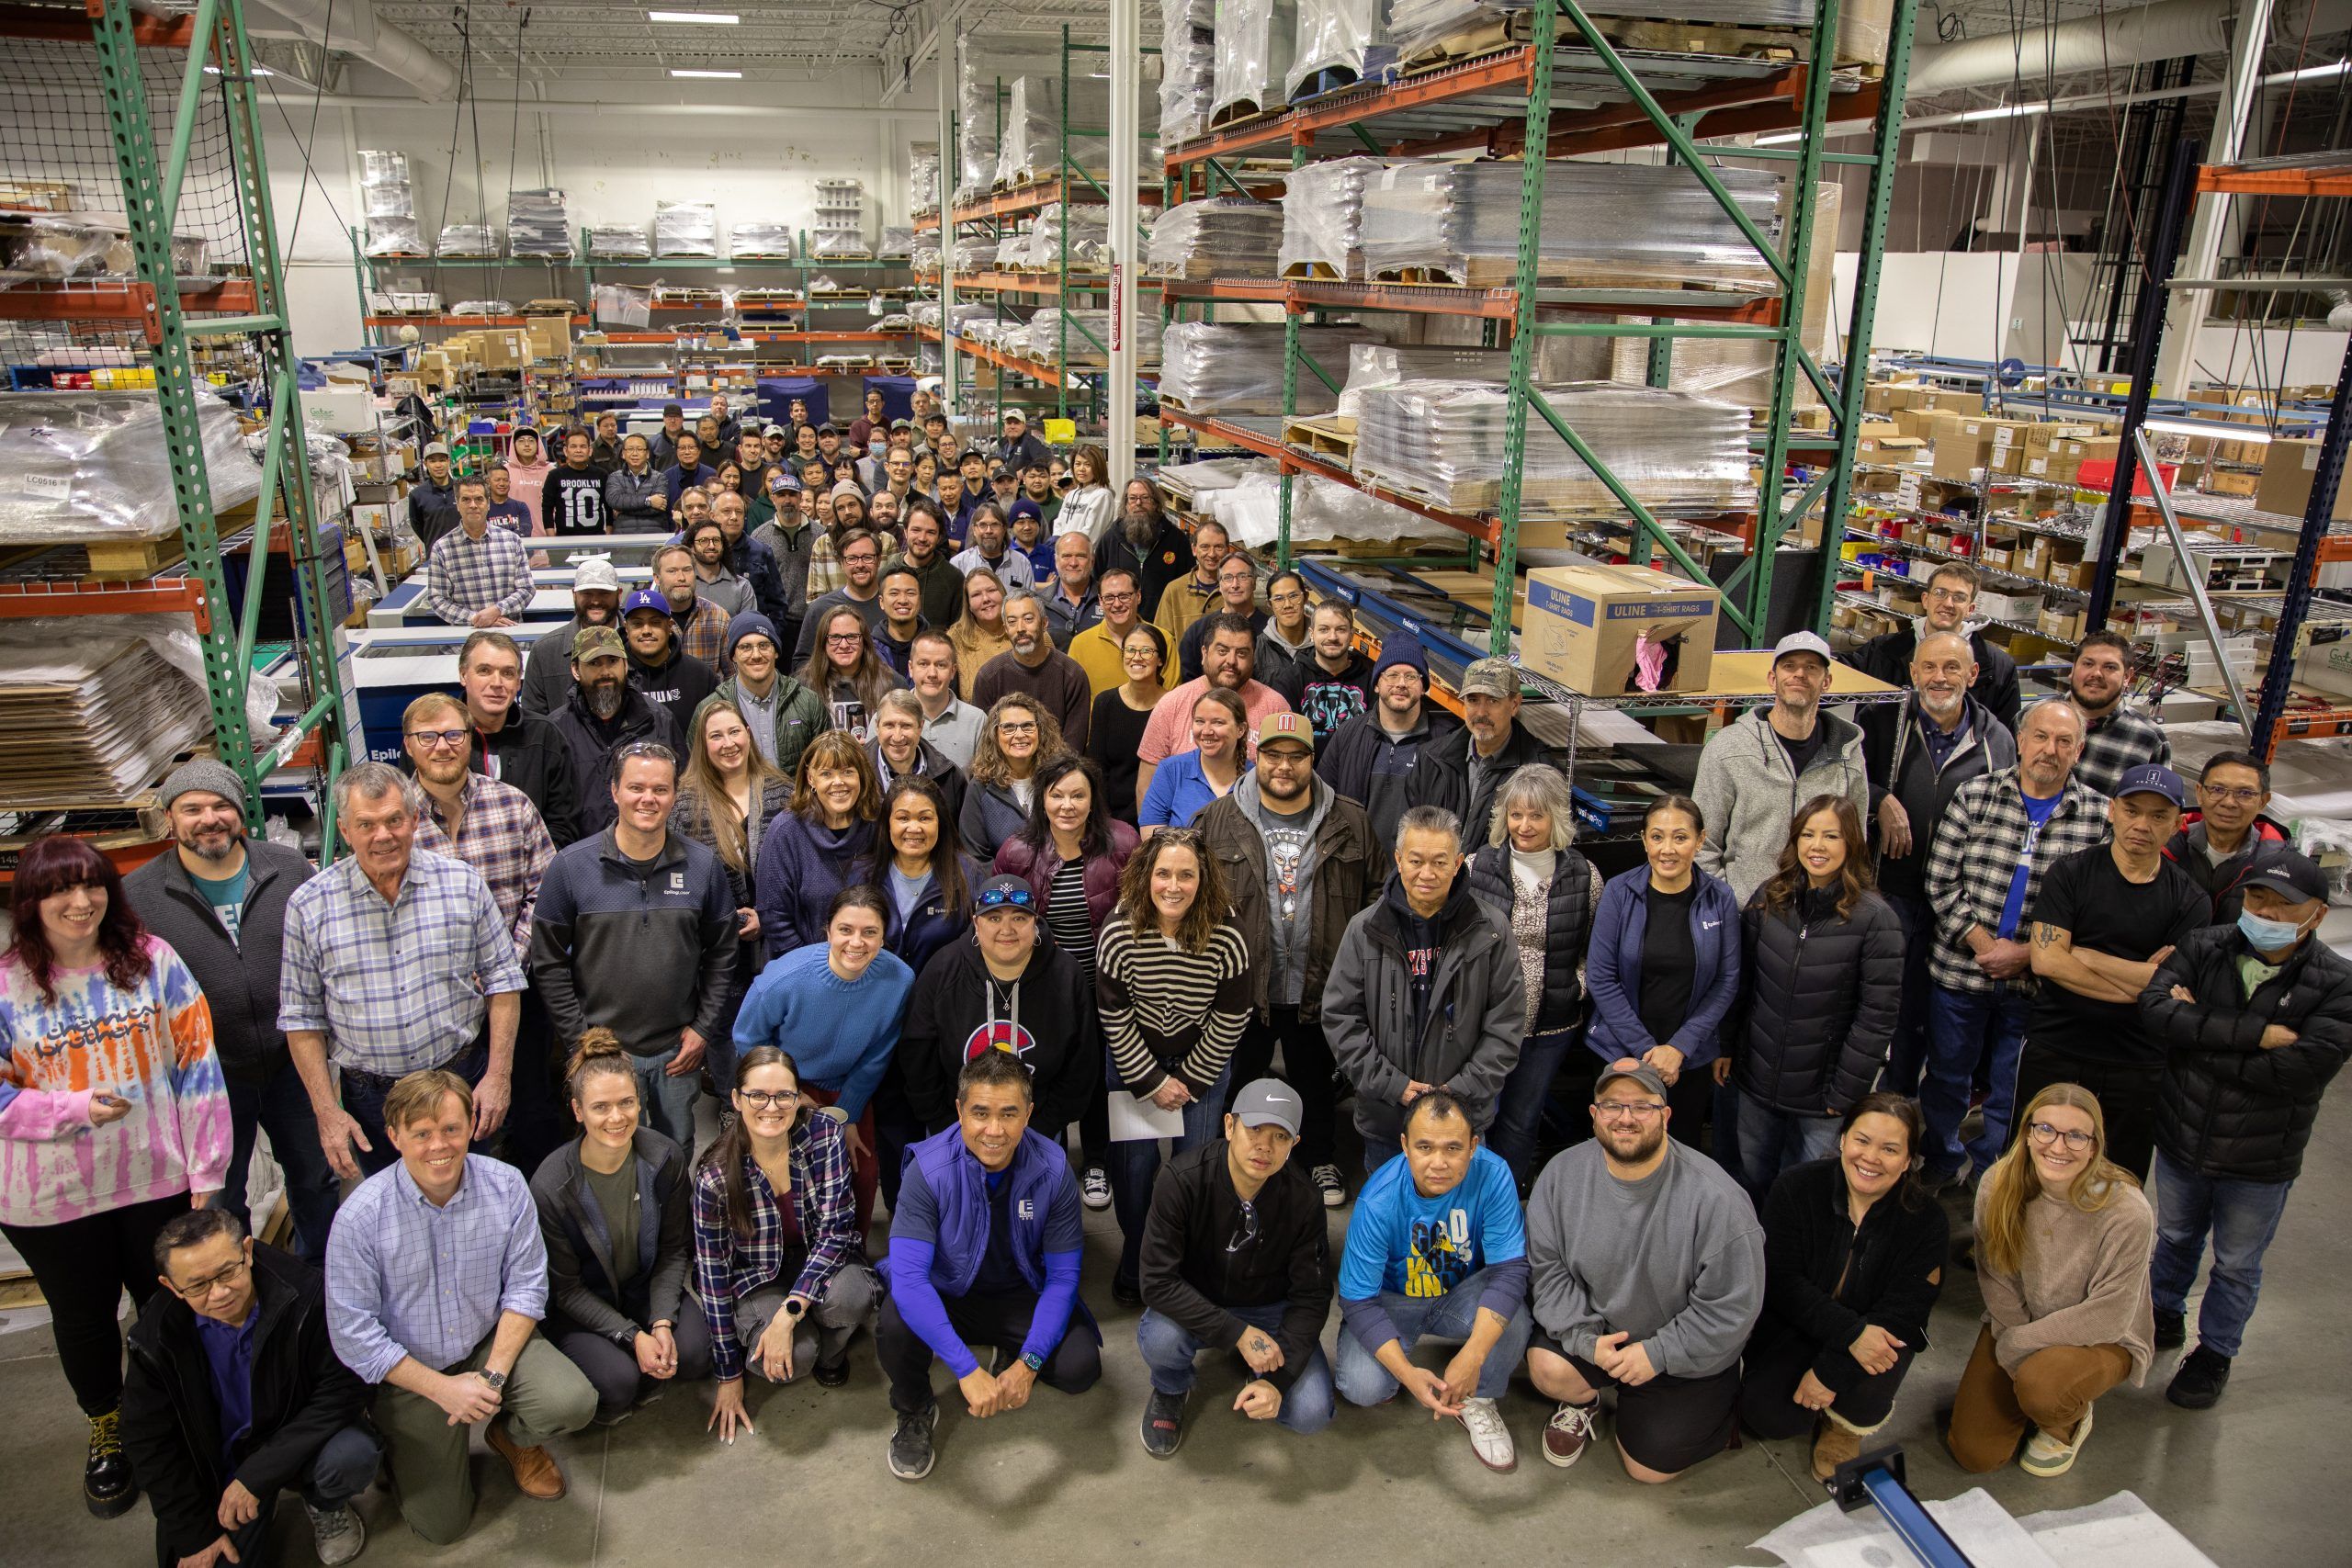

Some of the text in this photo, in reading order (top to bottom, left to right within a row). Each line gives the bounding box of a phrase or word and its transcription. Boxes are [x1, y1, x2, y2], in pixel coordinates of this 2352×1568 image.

[27, 475, 58, 487] LC0516
[561, 479, 601, 489] BROOKLYN
[561, 488, 601, 527] 10
[639, 592, 650, 604] LA
[1550, 589, 1571, 606] ULINE
[1545, 600, 1574, 617] T-SHIRT RAGS
[1614, 604, 1701, 617] ULINE T-SHIRT RAGS
[2330, 649, 2352, 665] Gat
[2267, 868, 2290, 878] adidas
[48, 999, 163, 1040] chemical
[35, 1020, 152, 1059] brothers
[1152, 1420, 1177, 1432] PUMA
